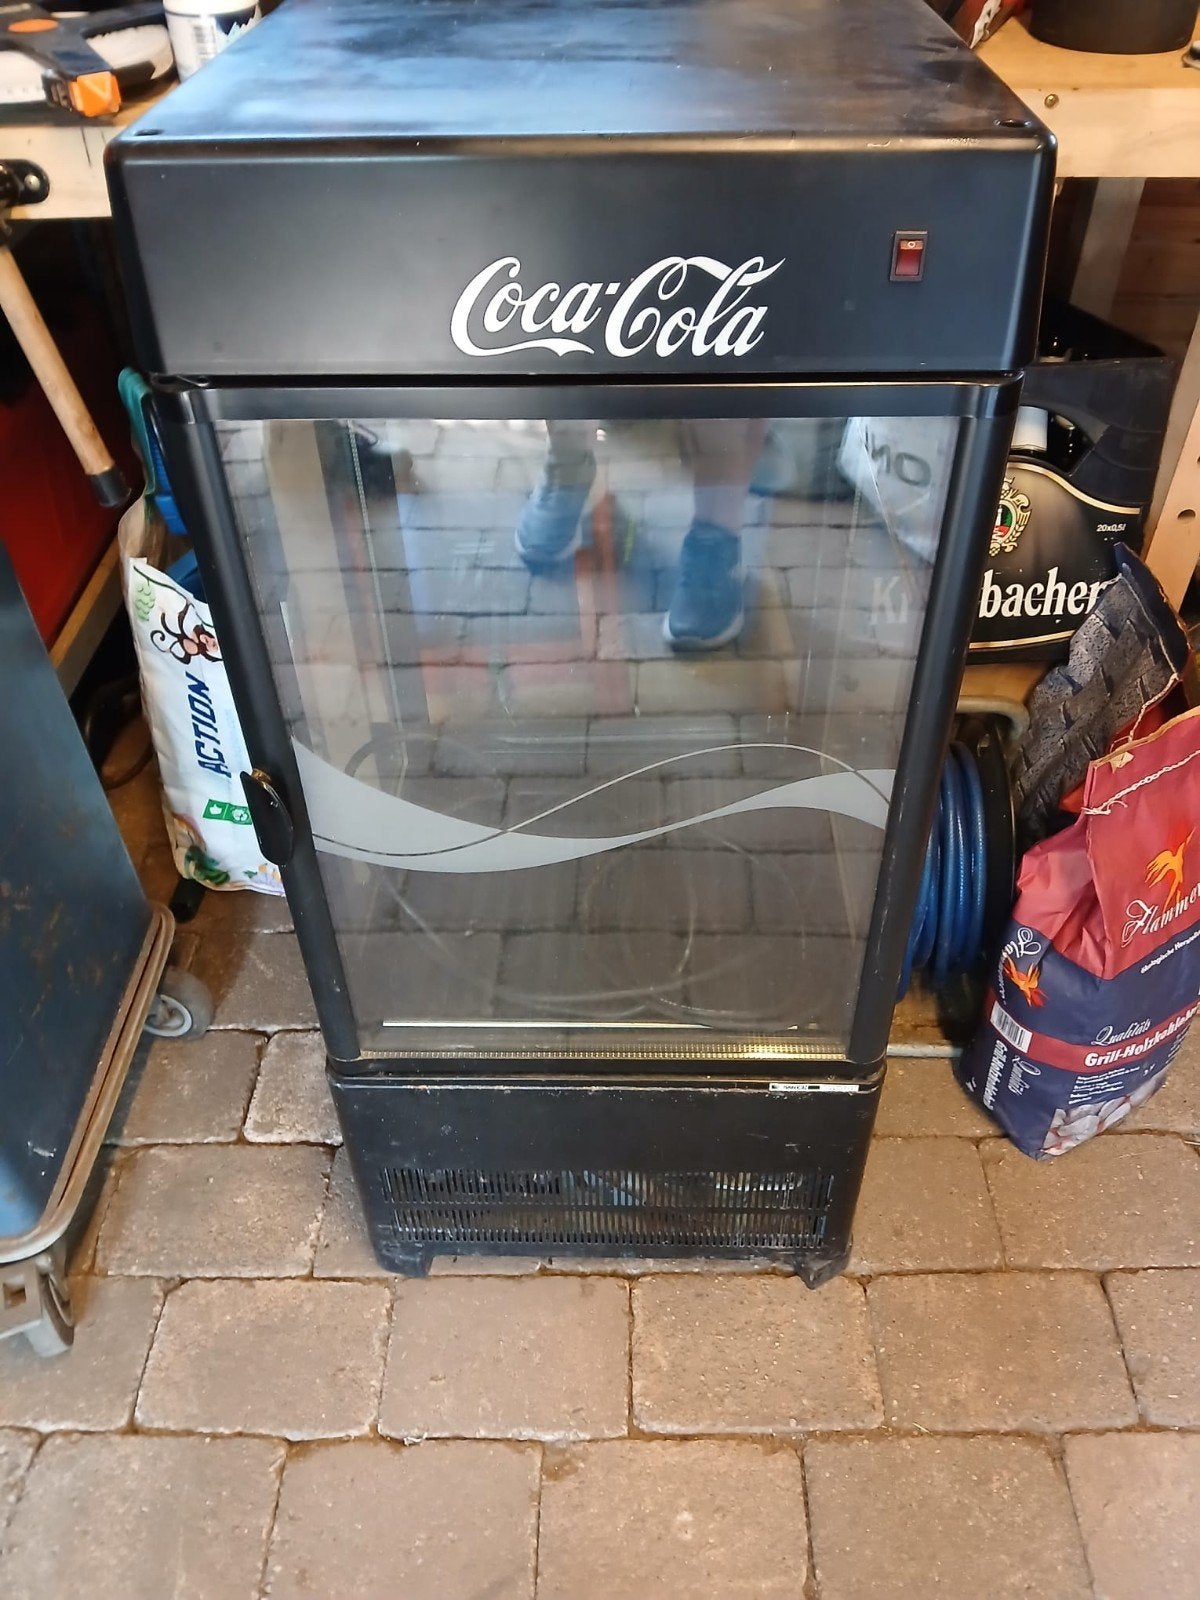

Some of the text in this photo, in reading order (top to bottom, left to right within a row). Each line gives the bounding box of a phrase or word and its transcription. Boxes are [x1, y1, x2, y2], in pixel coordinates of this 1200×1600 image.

[450, 255, 786, 358] Coca-Cola
[978, 566, 1108, 619] bacher
[185, 670, 232, 779] ACTION
